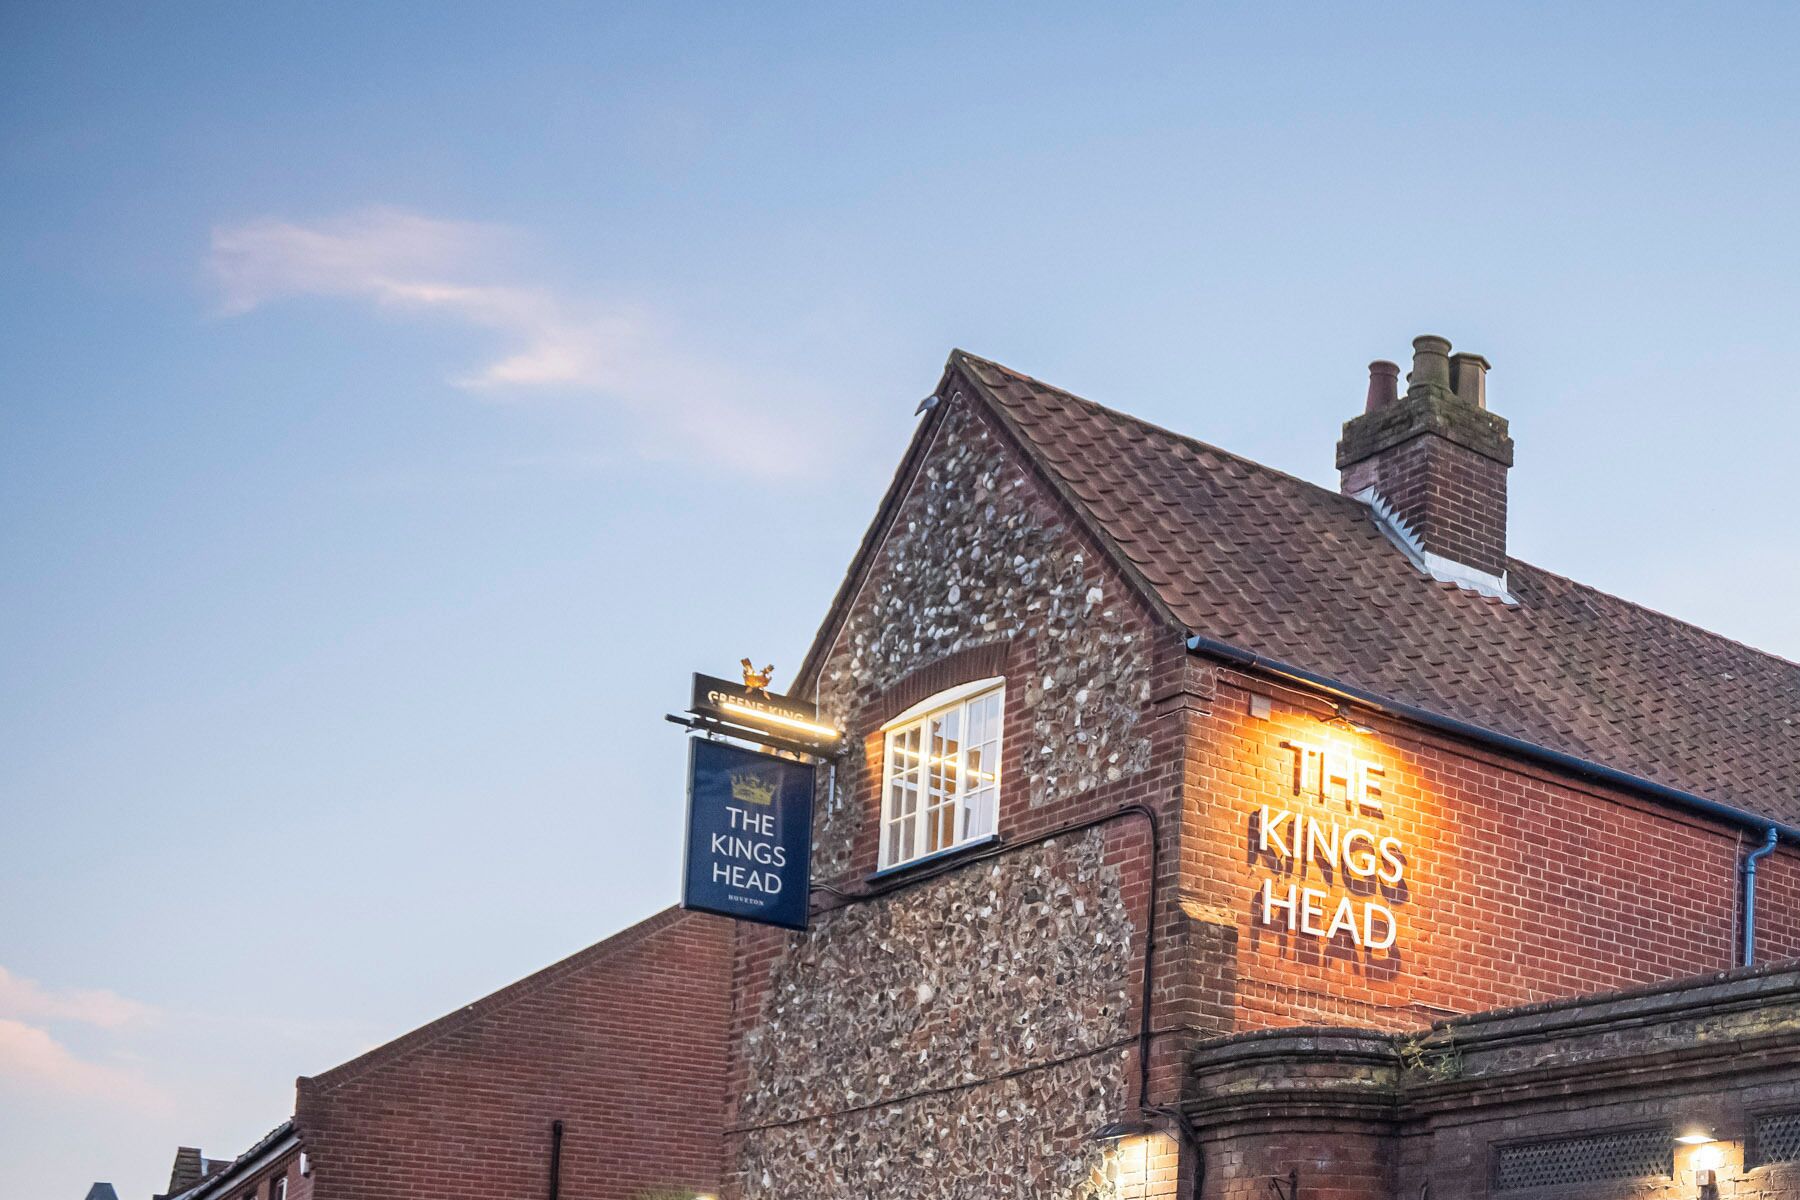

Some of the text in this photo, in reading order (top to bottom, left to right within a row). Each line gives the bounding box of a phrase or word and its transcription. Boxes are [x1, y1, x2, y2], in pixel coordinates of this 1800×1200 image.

[1288, 739, 1385, 810] THE
[725, 806, 775, 837] THE
[711, 832, 786, 868] KINGS
[1259, 804, 1403, 883] KINGS
[712, 862, 782, 894] HEAD
[728, 894, 764, 906] HOVETON
[1262, 878, 1397, 949] HEAD
